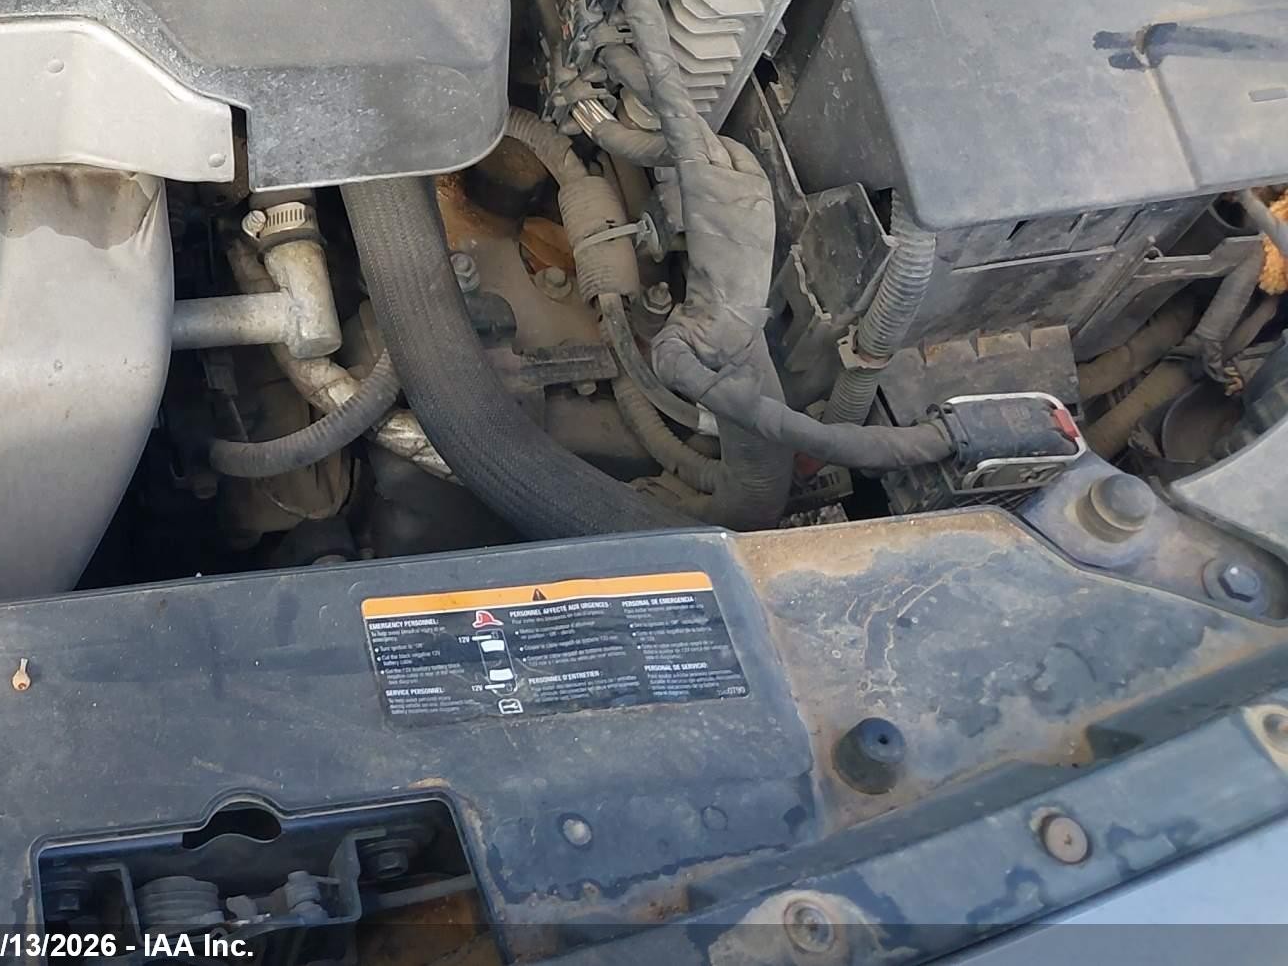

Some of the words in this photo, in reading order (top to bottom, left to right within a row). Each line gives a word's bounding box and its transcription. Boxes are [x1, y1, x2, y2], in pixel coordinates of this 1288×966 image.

[368, 621, 403, 631] EMERGENCY
[458, 635, 470, 644] 12V
[385, 689, 409, 697] SERVICE
